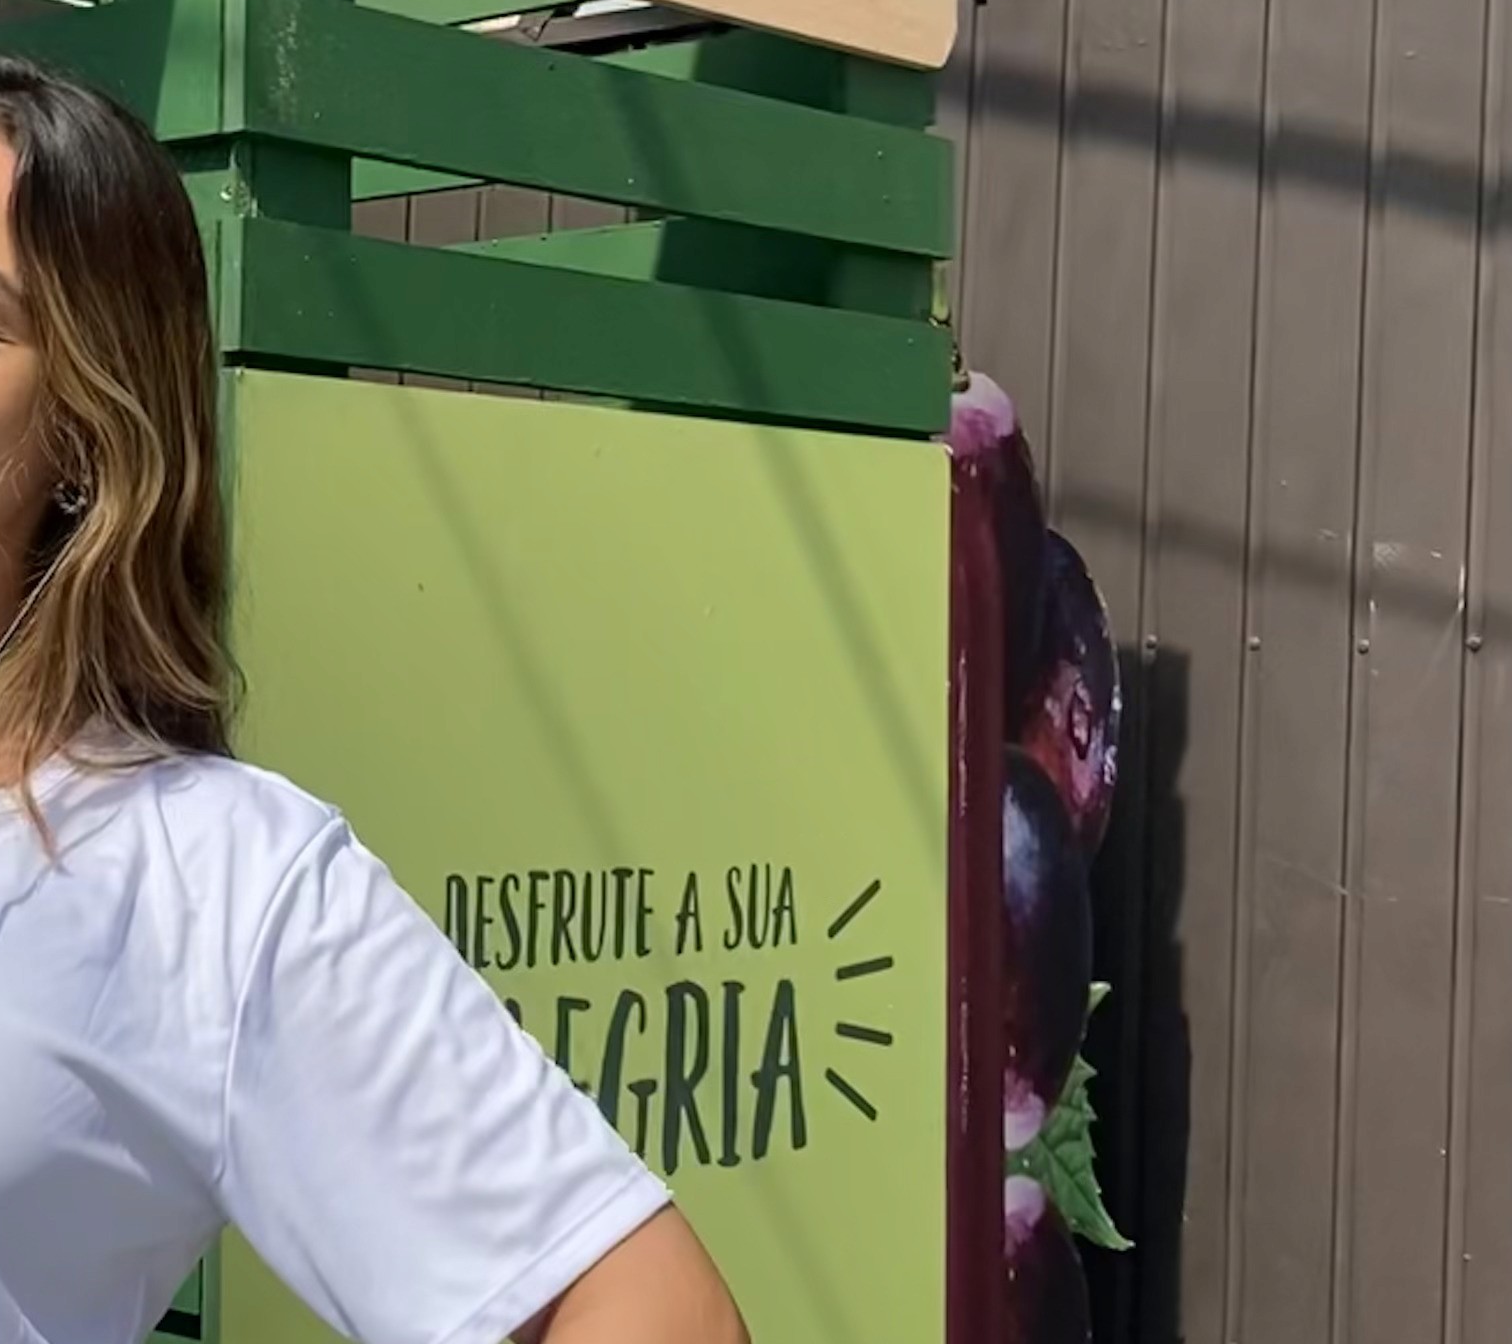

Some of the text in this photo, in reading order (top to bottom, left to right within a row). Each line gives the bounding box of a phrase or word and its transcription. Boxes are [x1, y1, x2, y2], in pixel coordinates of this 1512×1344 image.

[445, 862, 798, 971] DESFRUTE A SUA
